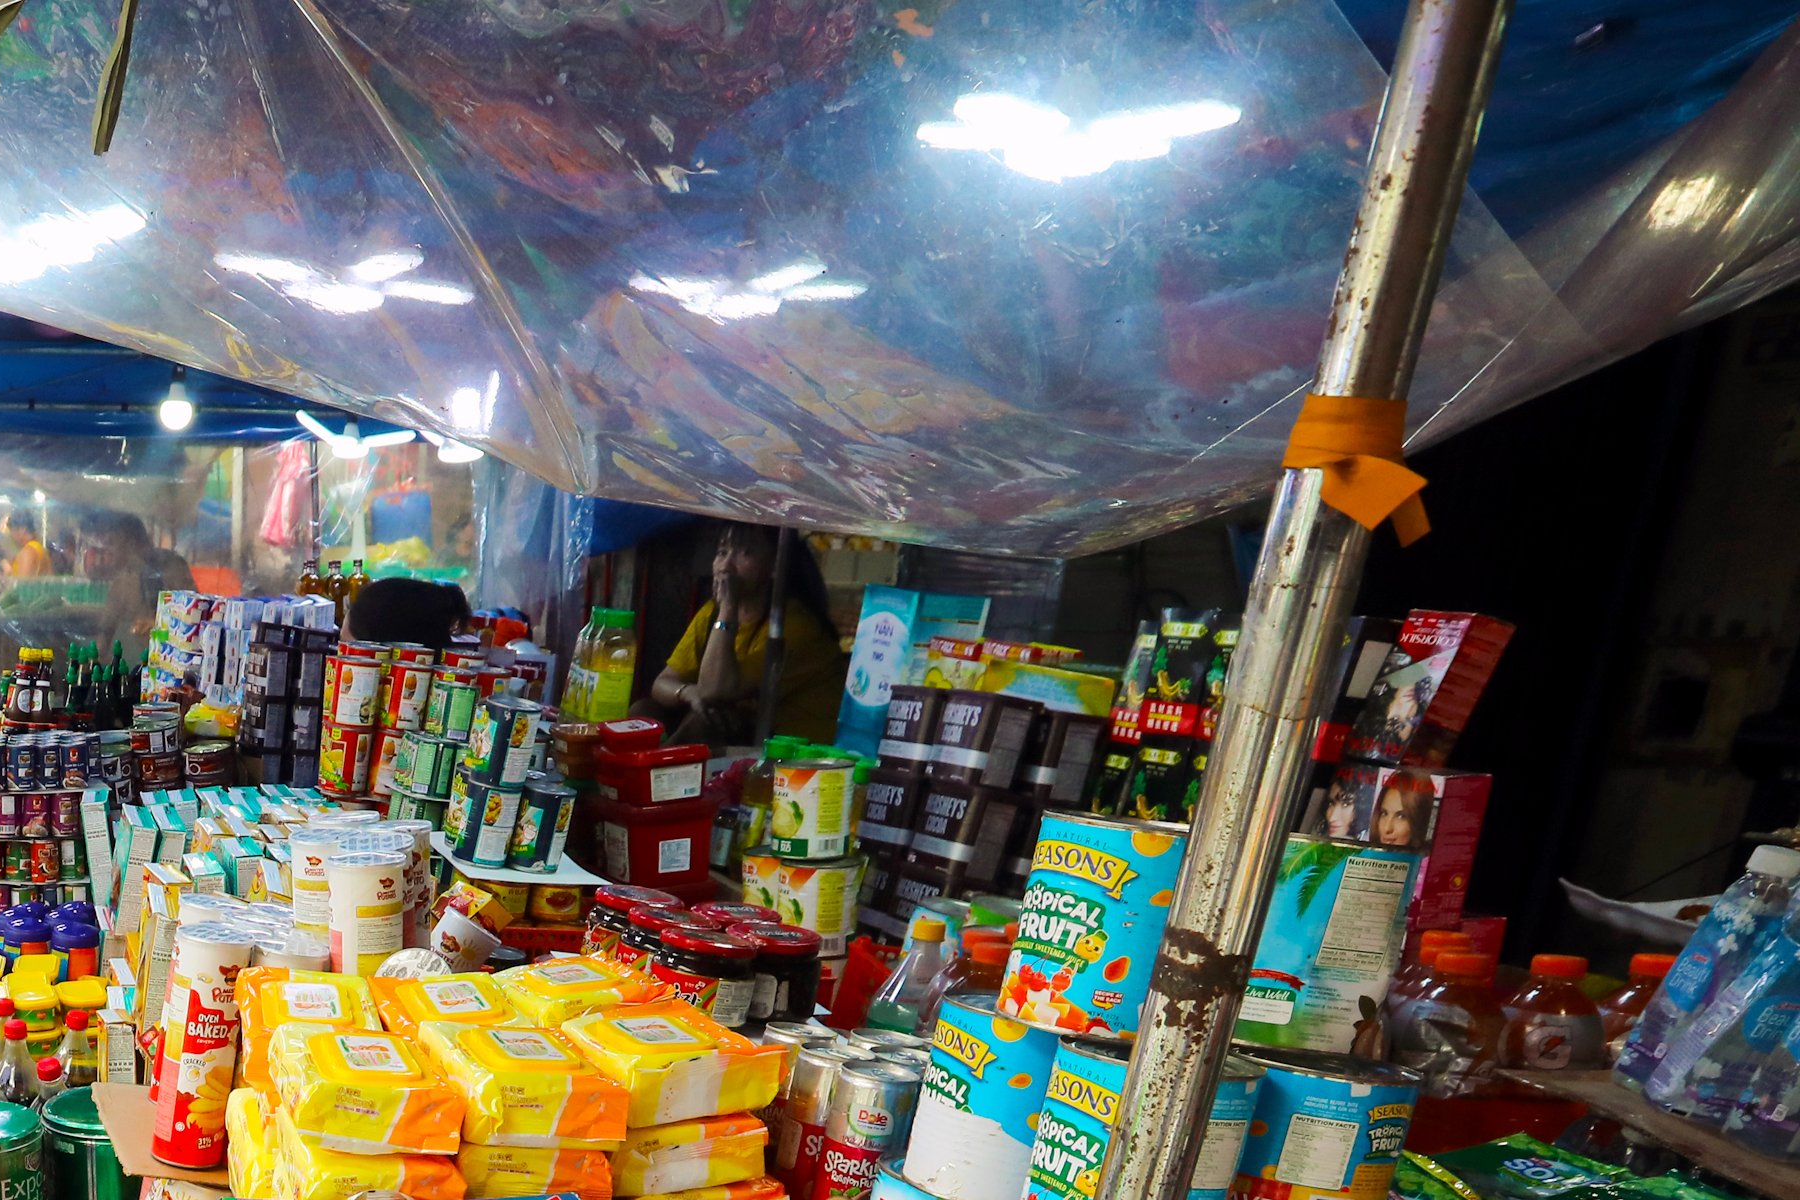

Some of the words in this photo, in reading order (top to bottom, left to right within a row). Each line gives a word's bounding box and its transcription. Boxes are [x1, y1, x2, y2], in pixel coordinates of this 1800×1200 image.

[1055, 832, 1108, 849] NATURAL
[1033, 844, 1117, 881] SEASONS
[1348, 857, 1385, 870] Nutrition
[1019, 913, 1088, 949] FRUIT
[198, 1014, 220, 1023] OVEN
[187, 1022, 229, 1040] BAKED
[183, 1057, 207, 1069] CRACKER
[858, 1109, 889, 1126] Dole
